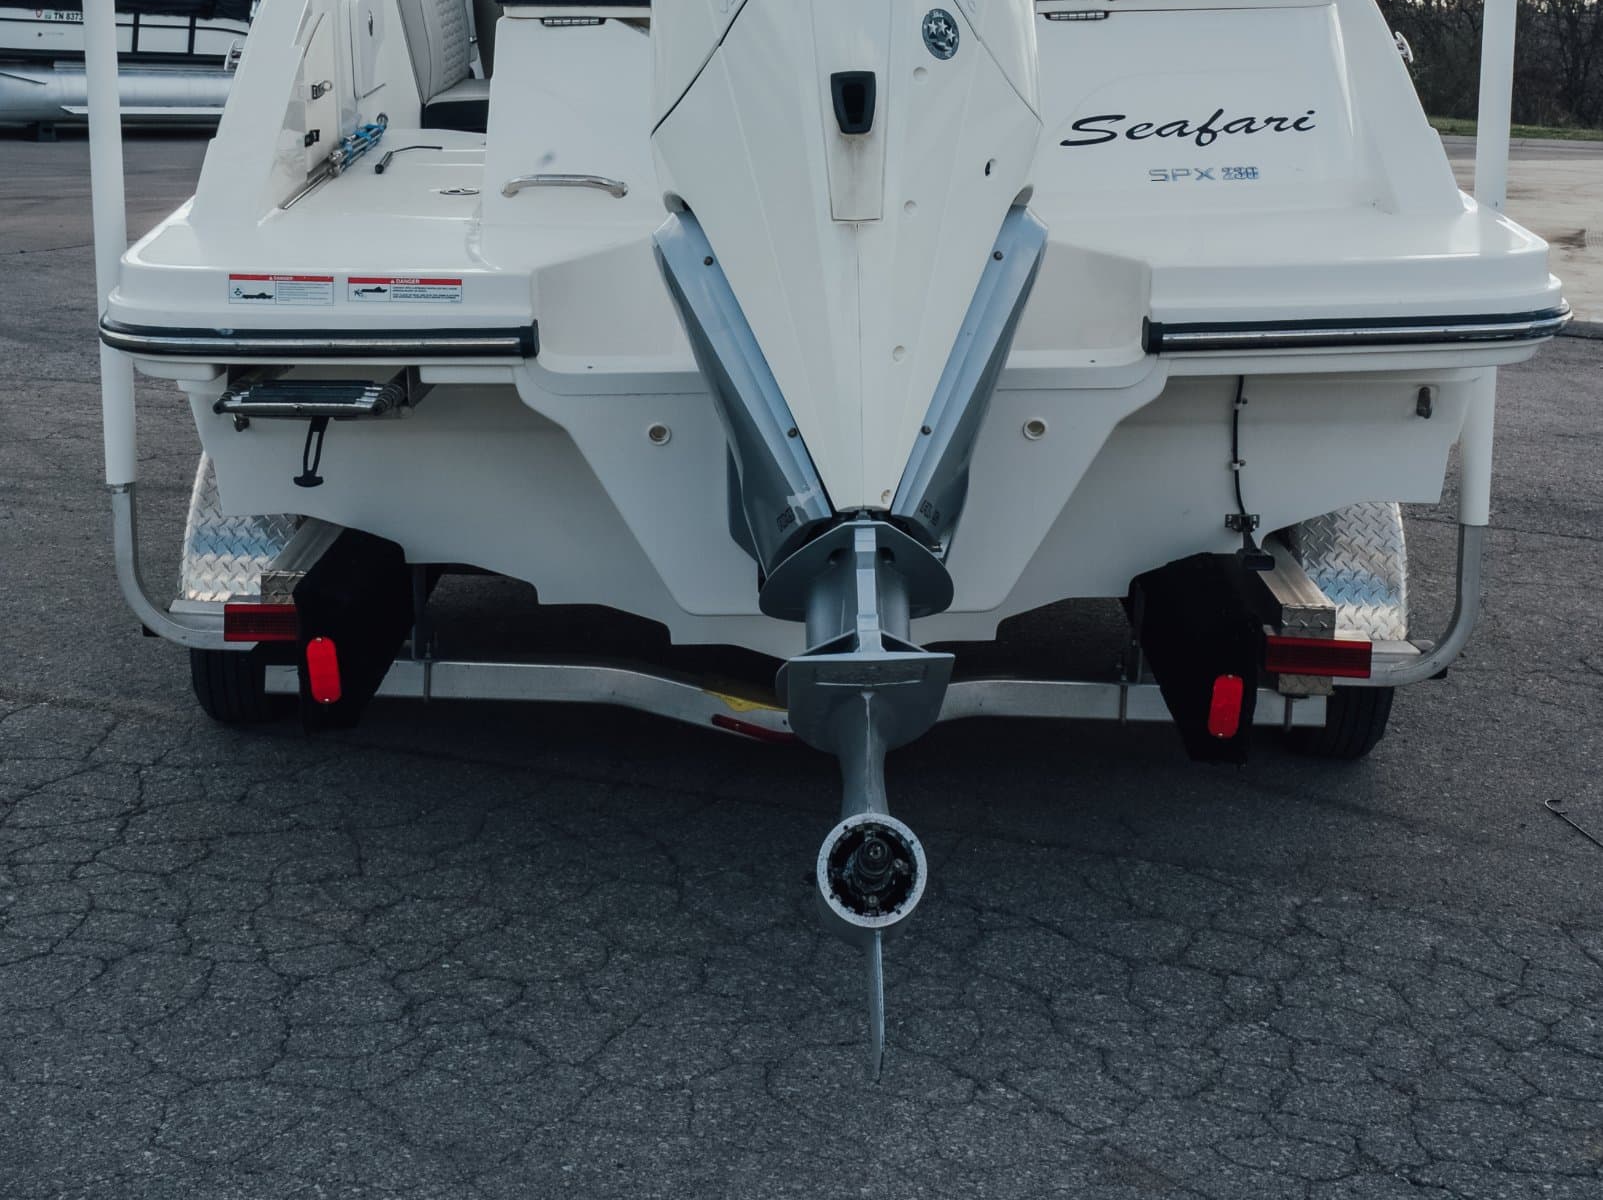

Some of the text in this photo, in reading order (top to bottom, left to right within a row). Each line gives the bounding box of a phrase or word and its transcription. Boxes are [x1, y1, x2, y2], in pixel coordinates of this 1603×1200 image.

[54, 12, 64, 20] TN
[1060, 108, 1316, 147] Seafari
[1149, 168, 1216, 181] SPX
